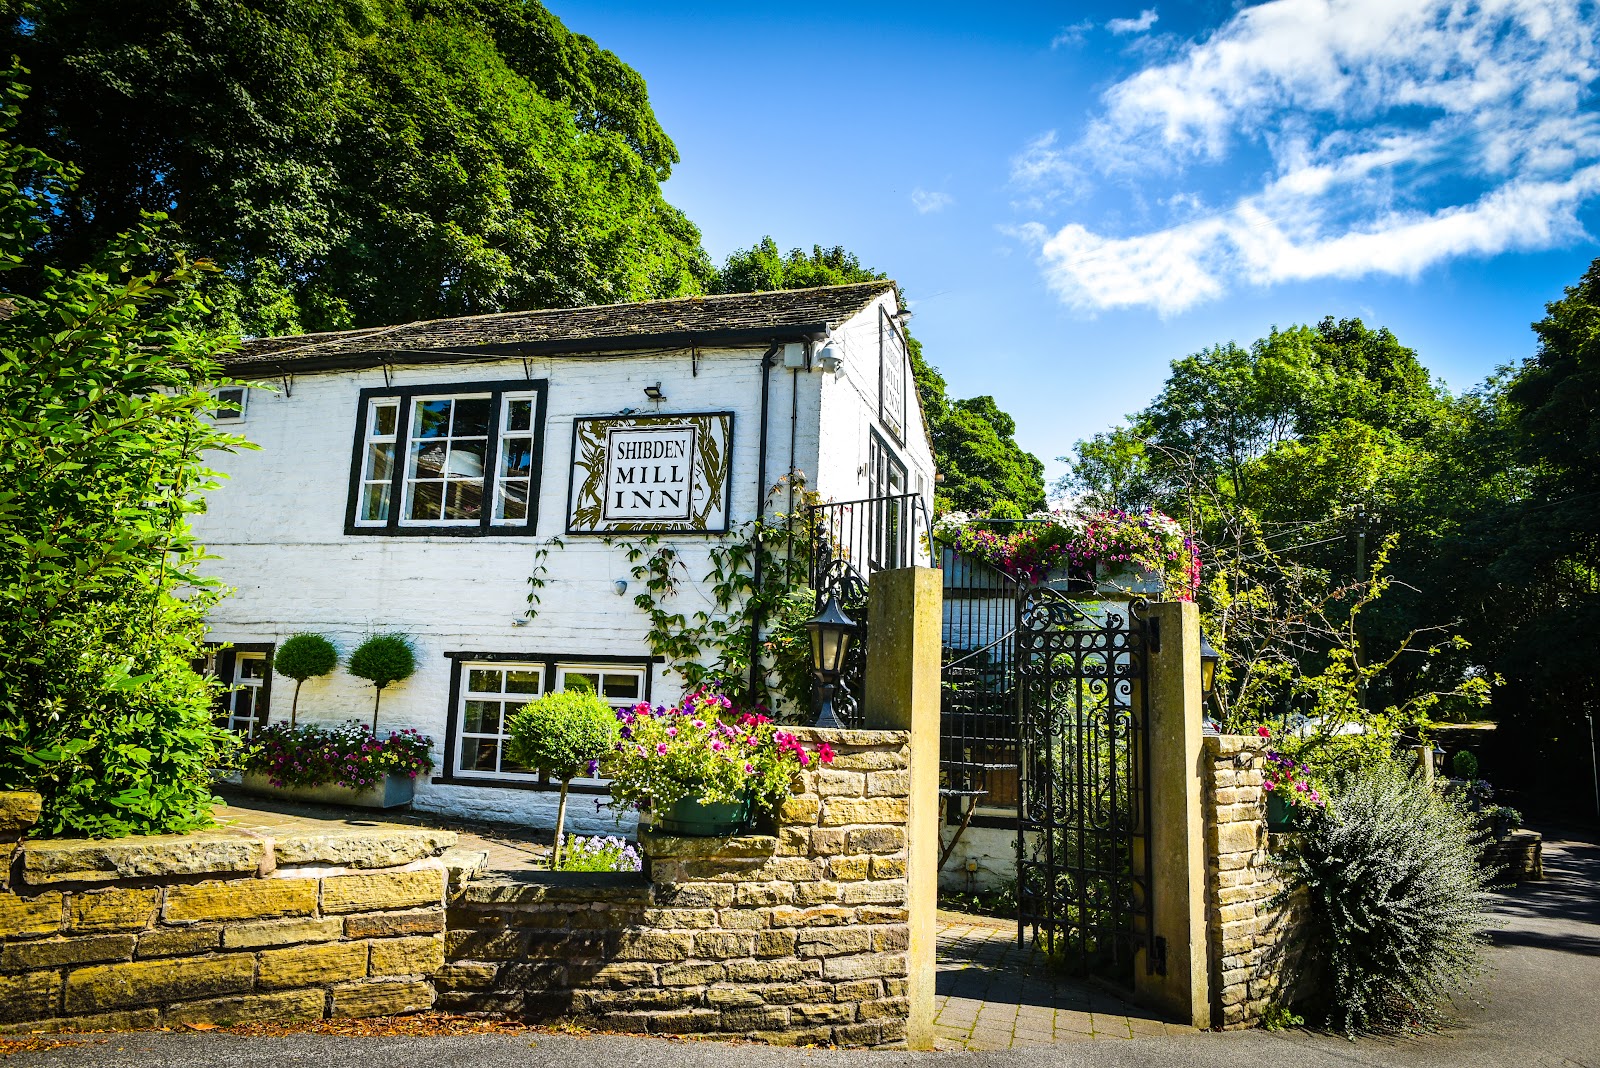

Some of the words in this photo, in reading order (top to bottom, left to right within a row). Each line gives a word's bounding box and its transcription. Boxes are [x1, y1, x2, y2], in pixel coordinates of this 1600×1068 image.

[617, 440, 686, 460] SHIBDEN
[615, 465, 684, 484] MILL
[614, 490, 683, 509] INN
